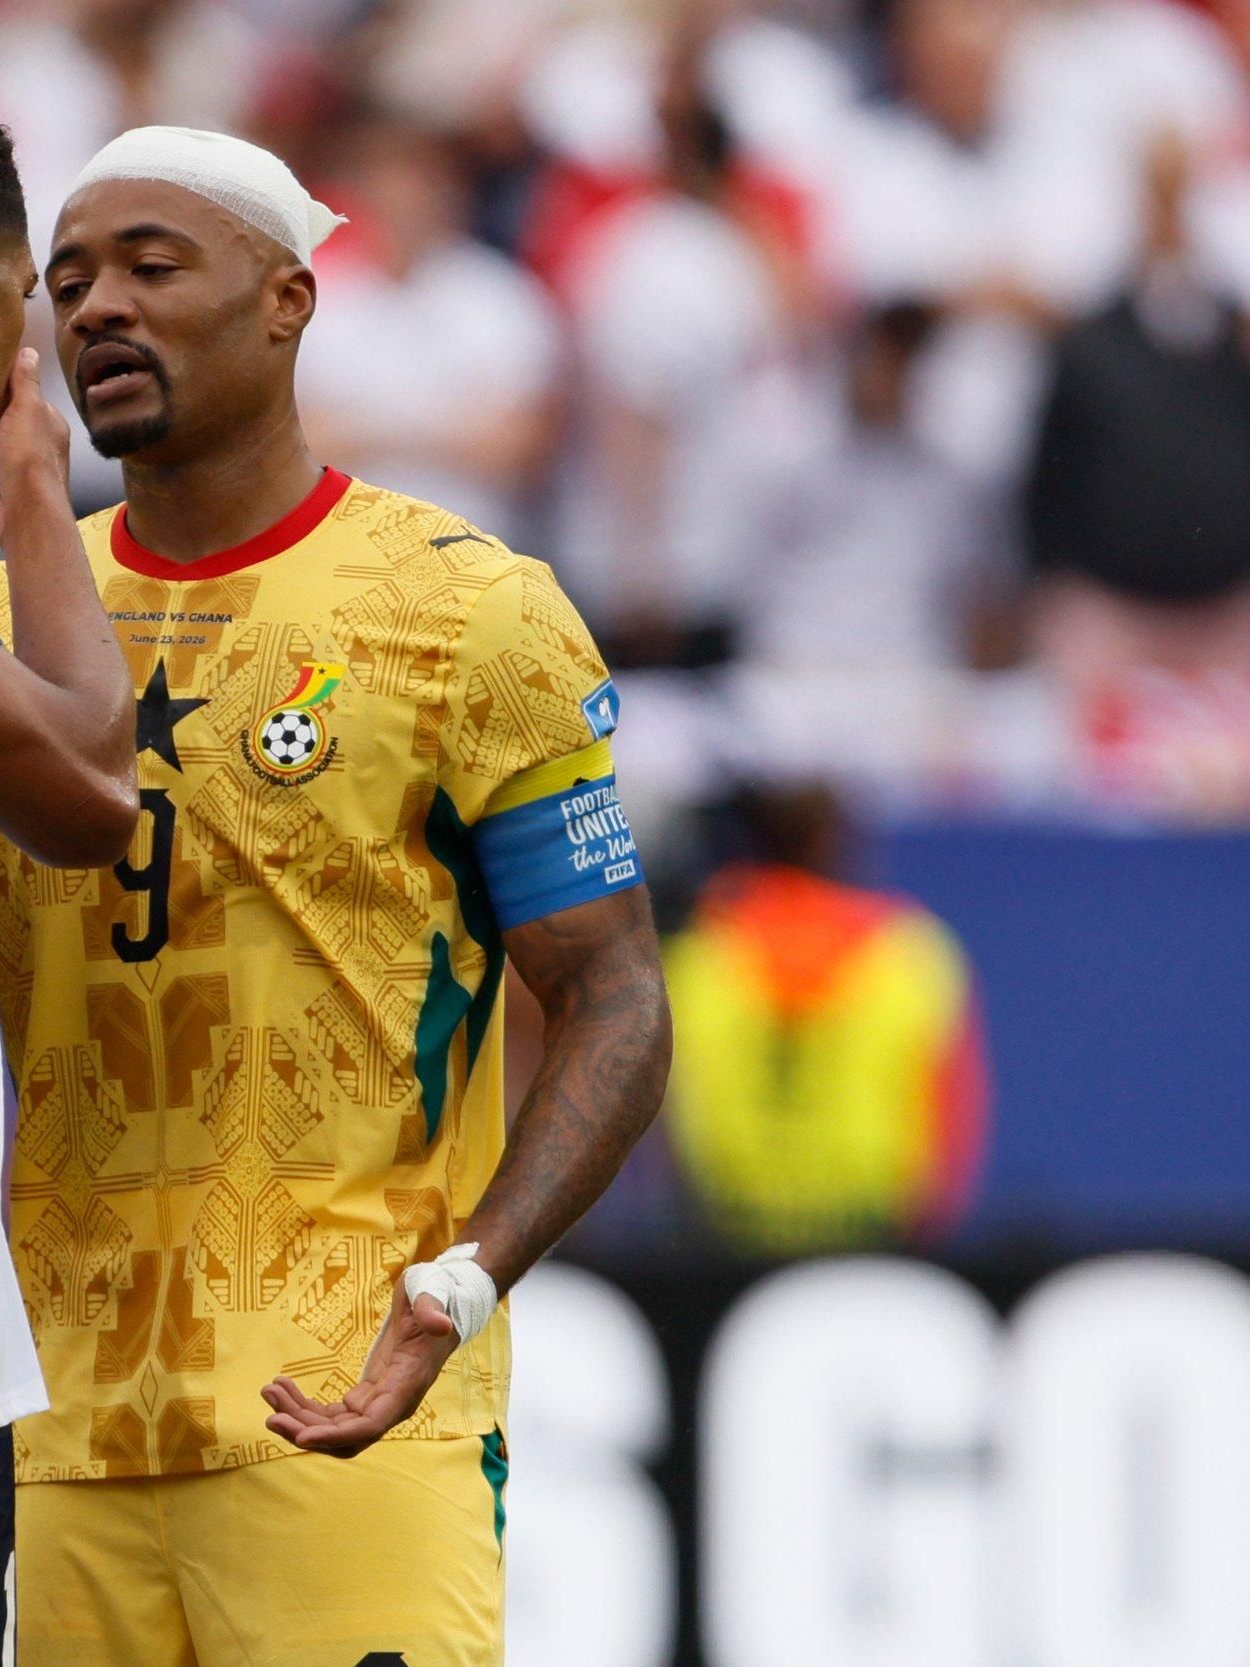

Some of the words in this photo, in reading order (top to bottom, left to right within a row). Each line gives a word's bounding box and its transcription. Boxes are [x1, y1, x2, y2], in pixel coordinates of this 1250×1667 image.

[107, 612, 166, 622] ENGLAND
[170, 612, 186, 622] VS
[189, 613, 233, 624] GHANA
[129, 634, 158, 644] June
[159, 635, 175, 645] 23,
[179, 636, 206, 645] 2026
[566, 804, 630, 845] UNITE
[568, 845, 606, 872] the
[111, 788, 177, 963] 9
[609, 863, 633, 880] FIFA
